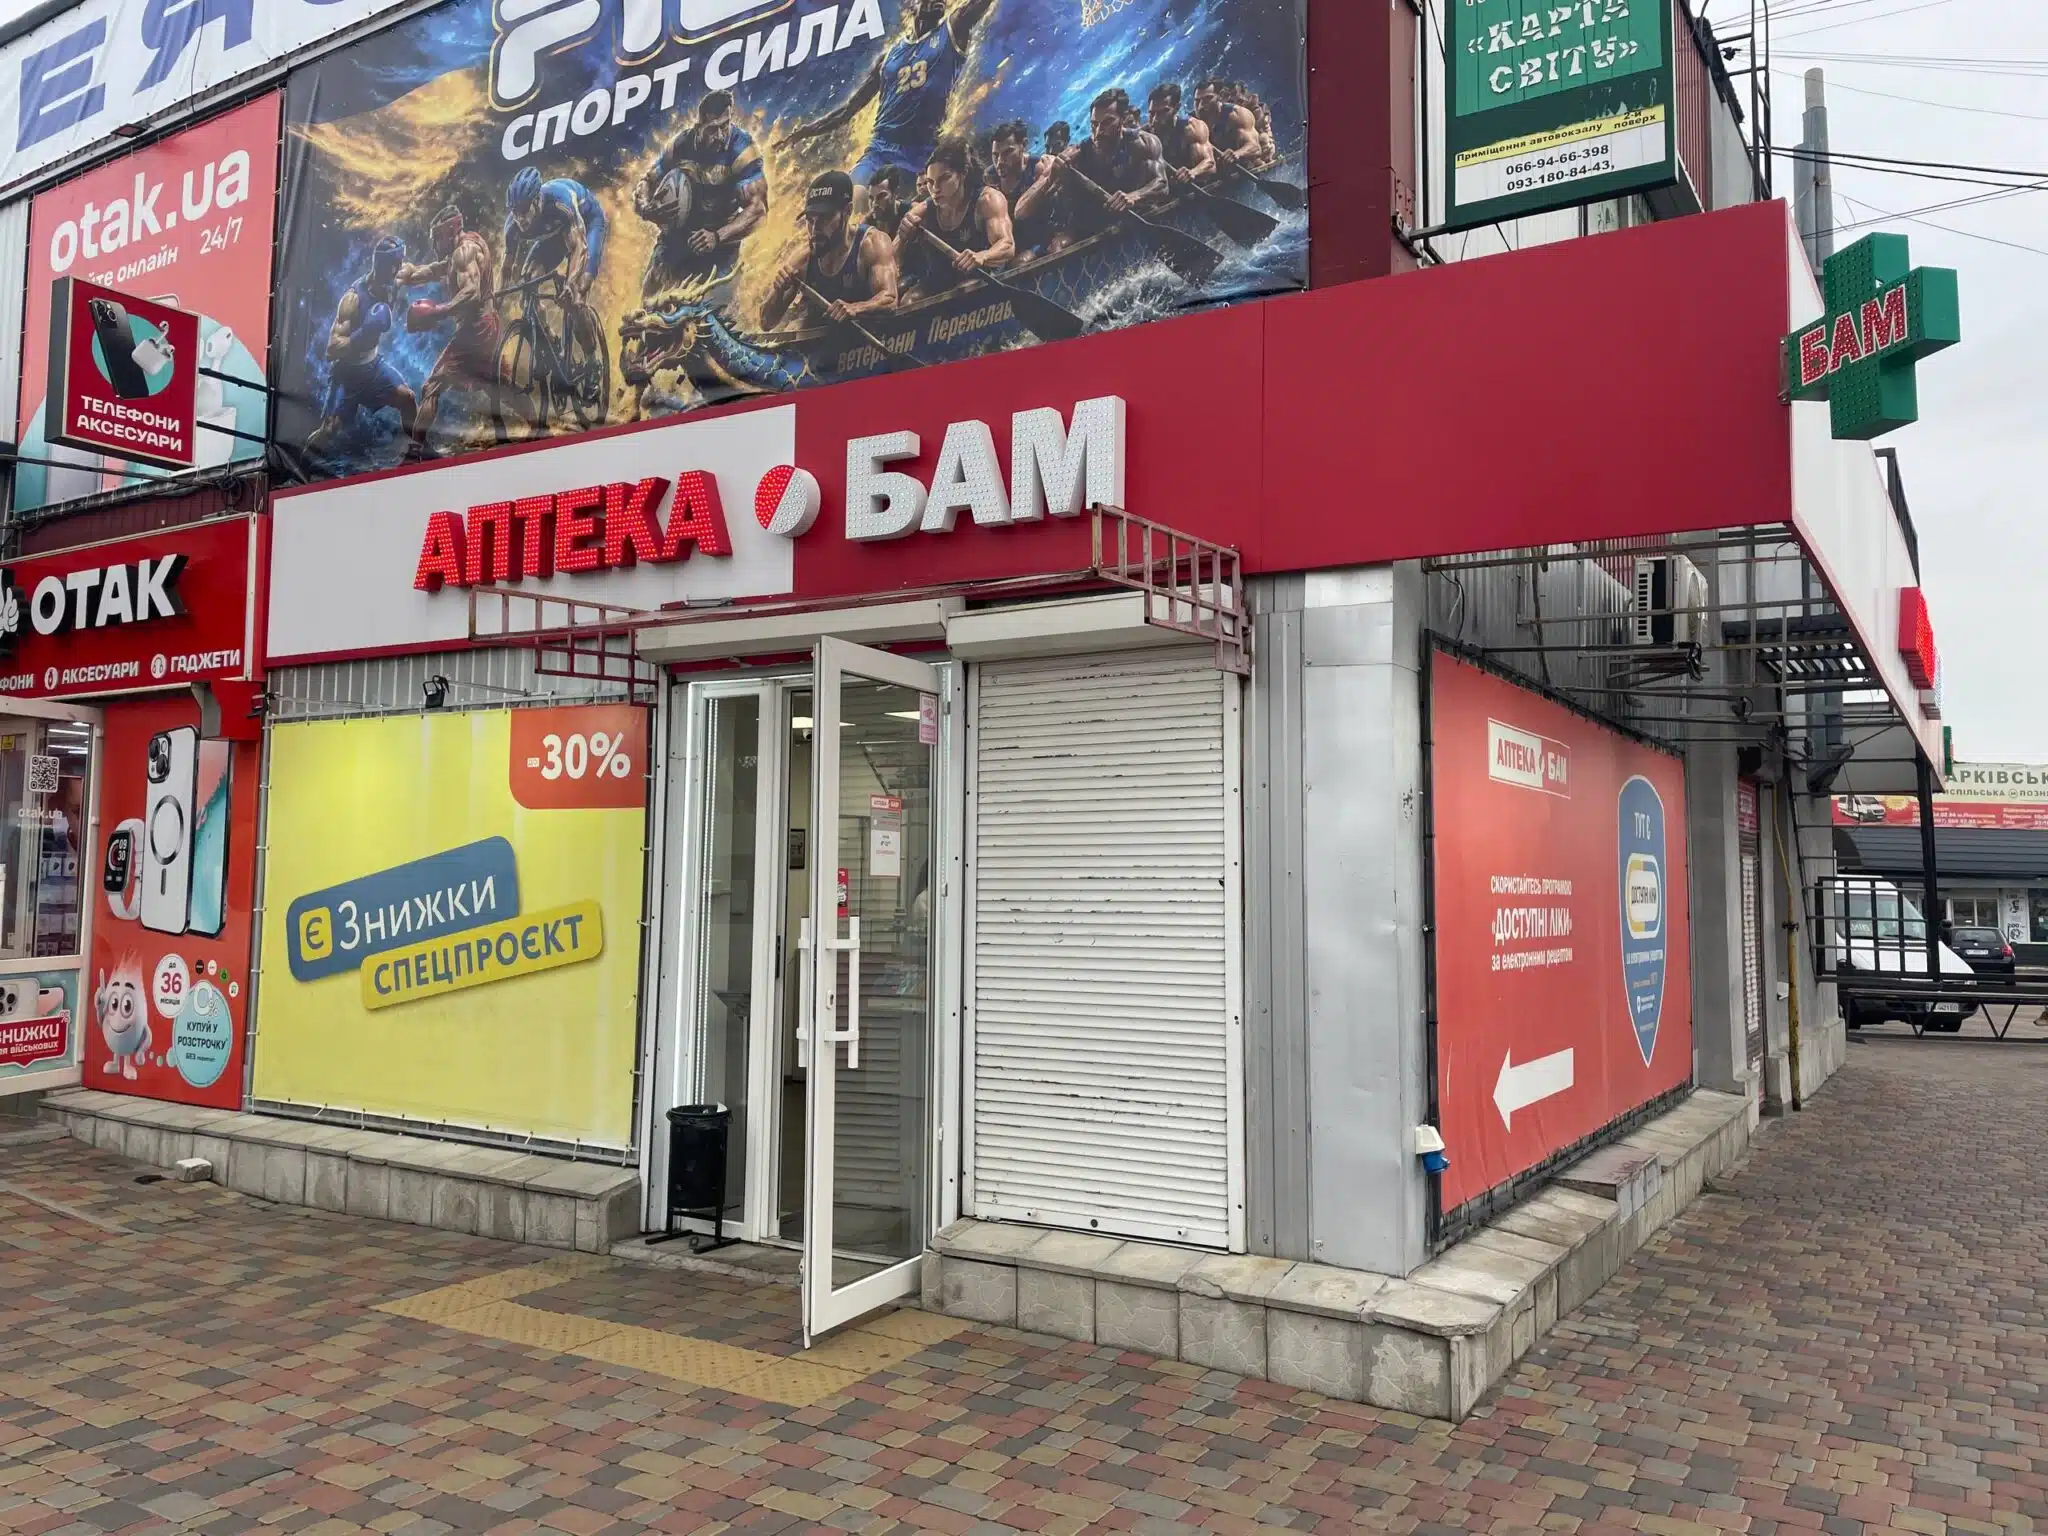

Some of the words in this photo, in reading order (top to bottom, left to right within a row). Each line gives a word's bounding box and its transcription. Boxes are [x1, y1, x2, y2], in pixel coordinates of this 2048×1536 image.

[501, 58, 691, 162] СПОРТ
[704, 0, 886, 90] СИЛА
[896, 60, 928, 94] 23
[1456, 141, 1527, 162] Приміщення
[1529, 122, 1603, 146] автовокзалу
[1613, 114, 1657, 130] поверх
[1506, 144, 1609, 175] 066-94-66-398
[50, 150, 250, 273] otak.ua
[200, 216, 243, 255] 24/7
[117, 244, 179, 283] онлайн
[1800, 284, 1908, 386] БАМ
[77, 414, 182, 452] АКСЕСУАРИ
[80, 394, 180, 433] ТЕЛЕФОНИ
[413, 470, 732, 592] АПТЕКА
[845, 396, 1126, 541] БАМ
[31, 554, 178, 636] ОТАК
[61, 661, 139, 685] АКСЕСУАРИ
[170, 649, 241, 673] ГАДЖЕТИ
[527, 732, 631, 780] -30%
[1497, 738, 1536, 775] АПТЕКА
[1548, 751, 1567, 784] БАМ
[18, 806, 63, 819] otak.ua
[1490, 874, 1541, 895] СКОРИСТАЙТЕСЬ
[374, 914, 584, 994] СПЕЦПРОЄКТ
[1491, 954, 1501, 971] за
[1502, 951, 1546, 972] електронним
[160, 972, 182, 994] 36
[186, 1020, 211, 1033] КУПУЙ
[213, 1023, 218, 1033] У
